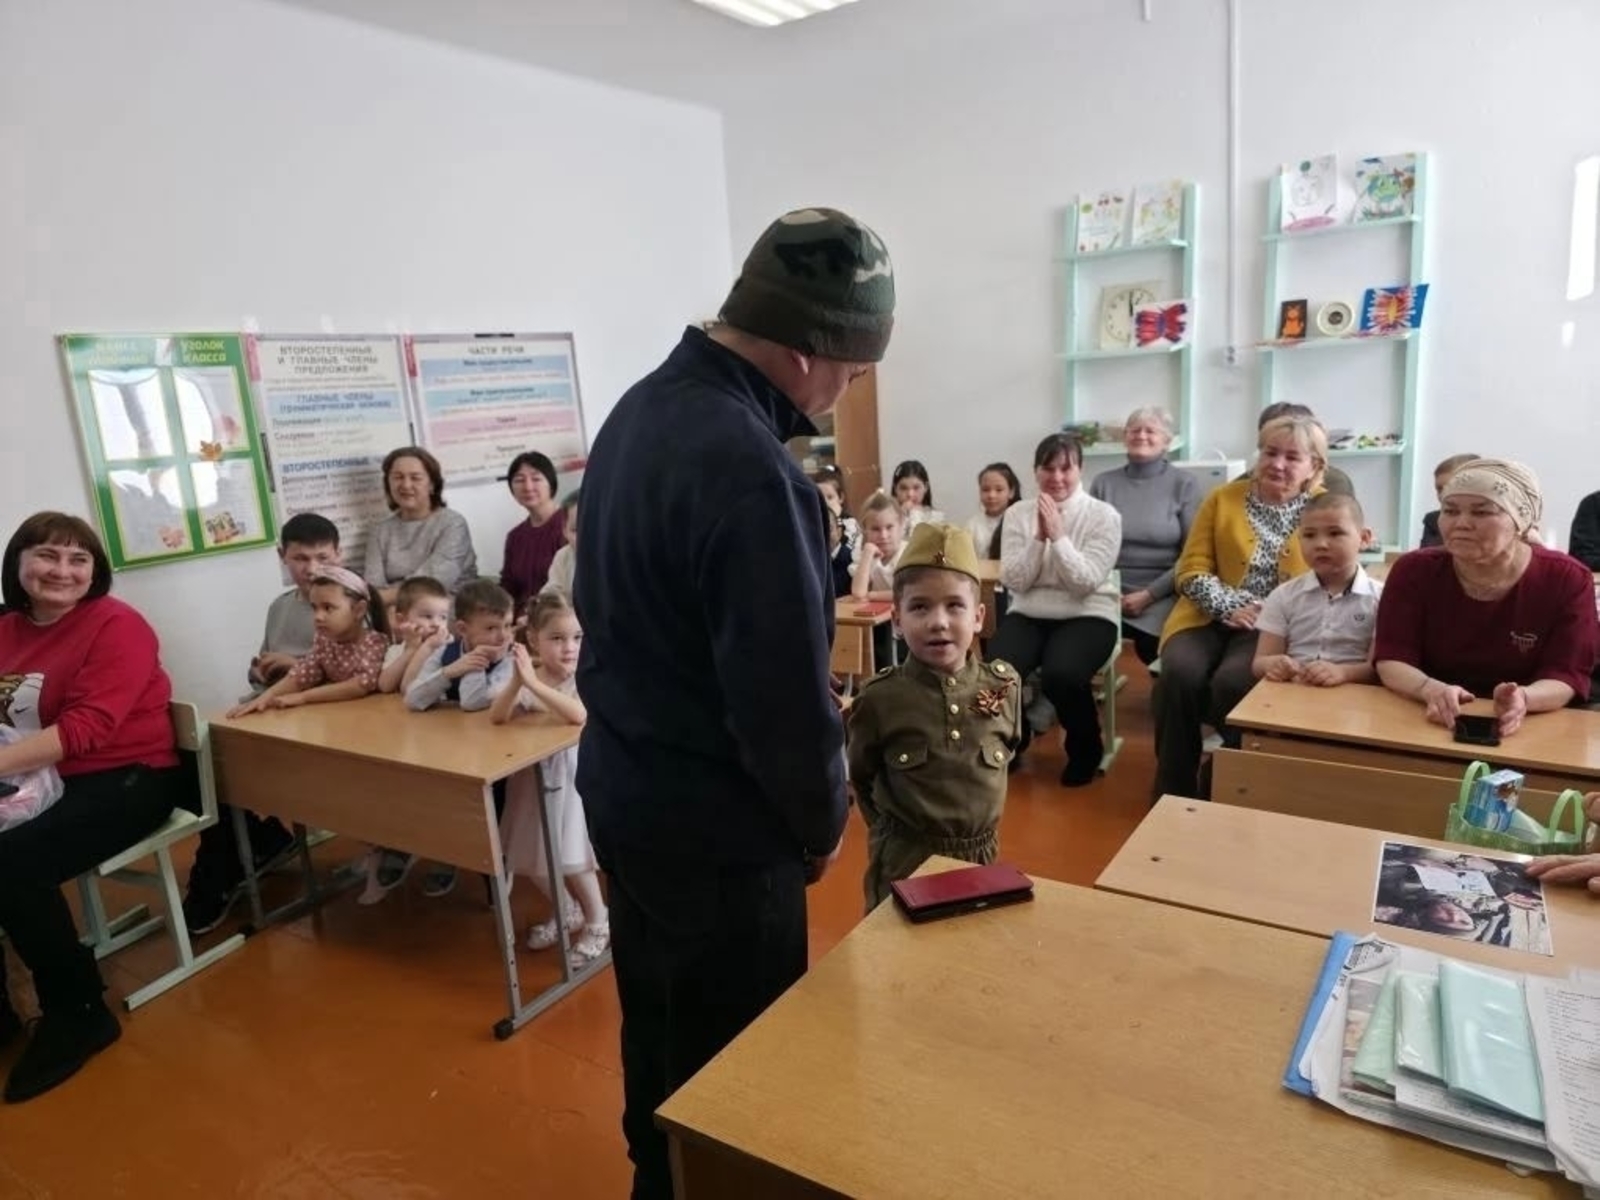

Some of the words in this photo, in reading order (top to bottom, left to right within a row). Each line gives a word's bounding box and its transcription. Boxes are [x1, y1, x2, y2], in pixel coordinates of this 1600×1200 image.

[280, 345, 372, 356] ВТОРОСТЕПЕННЫЕ
[468, 345, 496, 355] ЧАСТИ
[277, 356, 285, 365] И
[290, 355, 340, 365] ГЛАВНЫЕ
[343, 355, 378, 364] ЧЛЕНЫ
[294, 364, 369, 375] ПРЕДЛОЖЕНИЯ
[296, 392, 340, 403] ГЛАВНЫЕ
[343, 391, 374, 402] ЧЛЕНЫ
[282, 456, 370, 474] ВТОРОСТЕПЕННЫЕ
